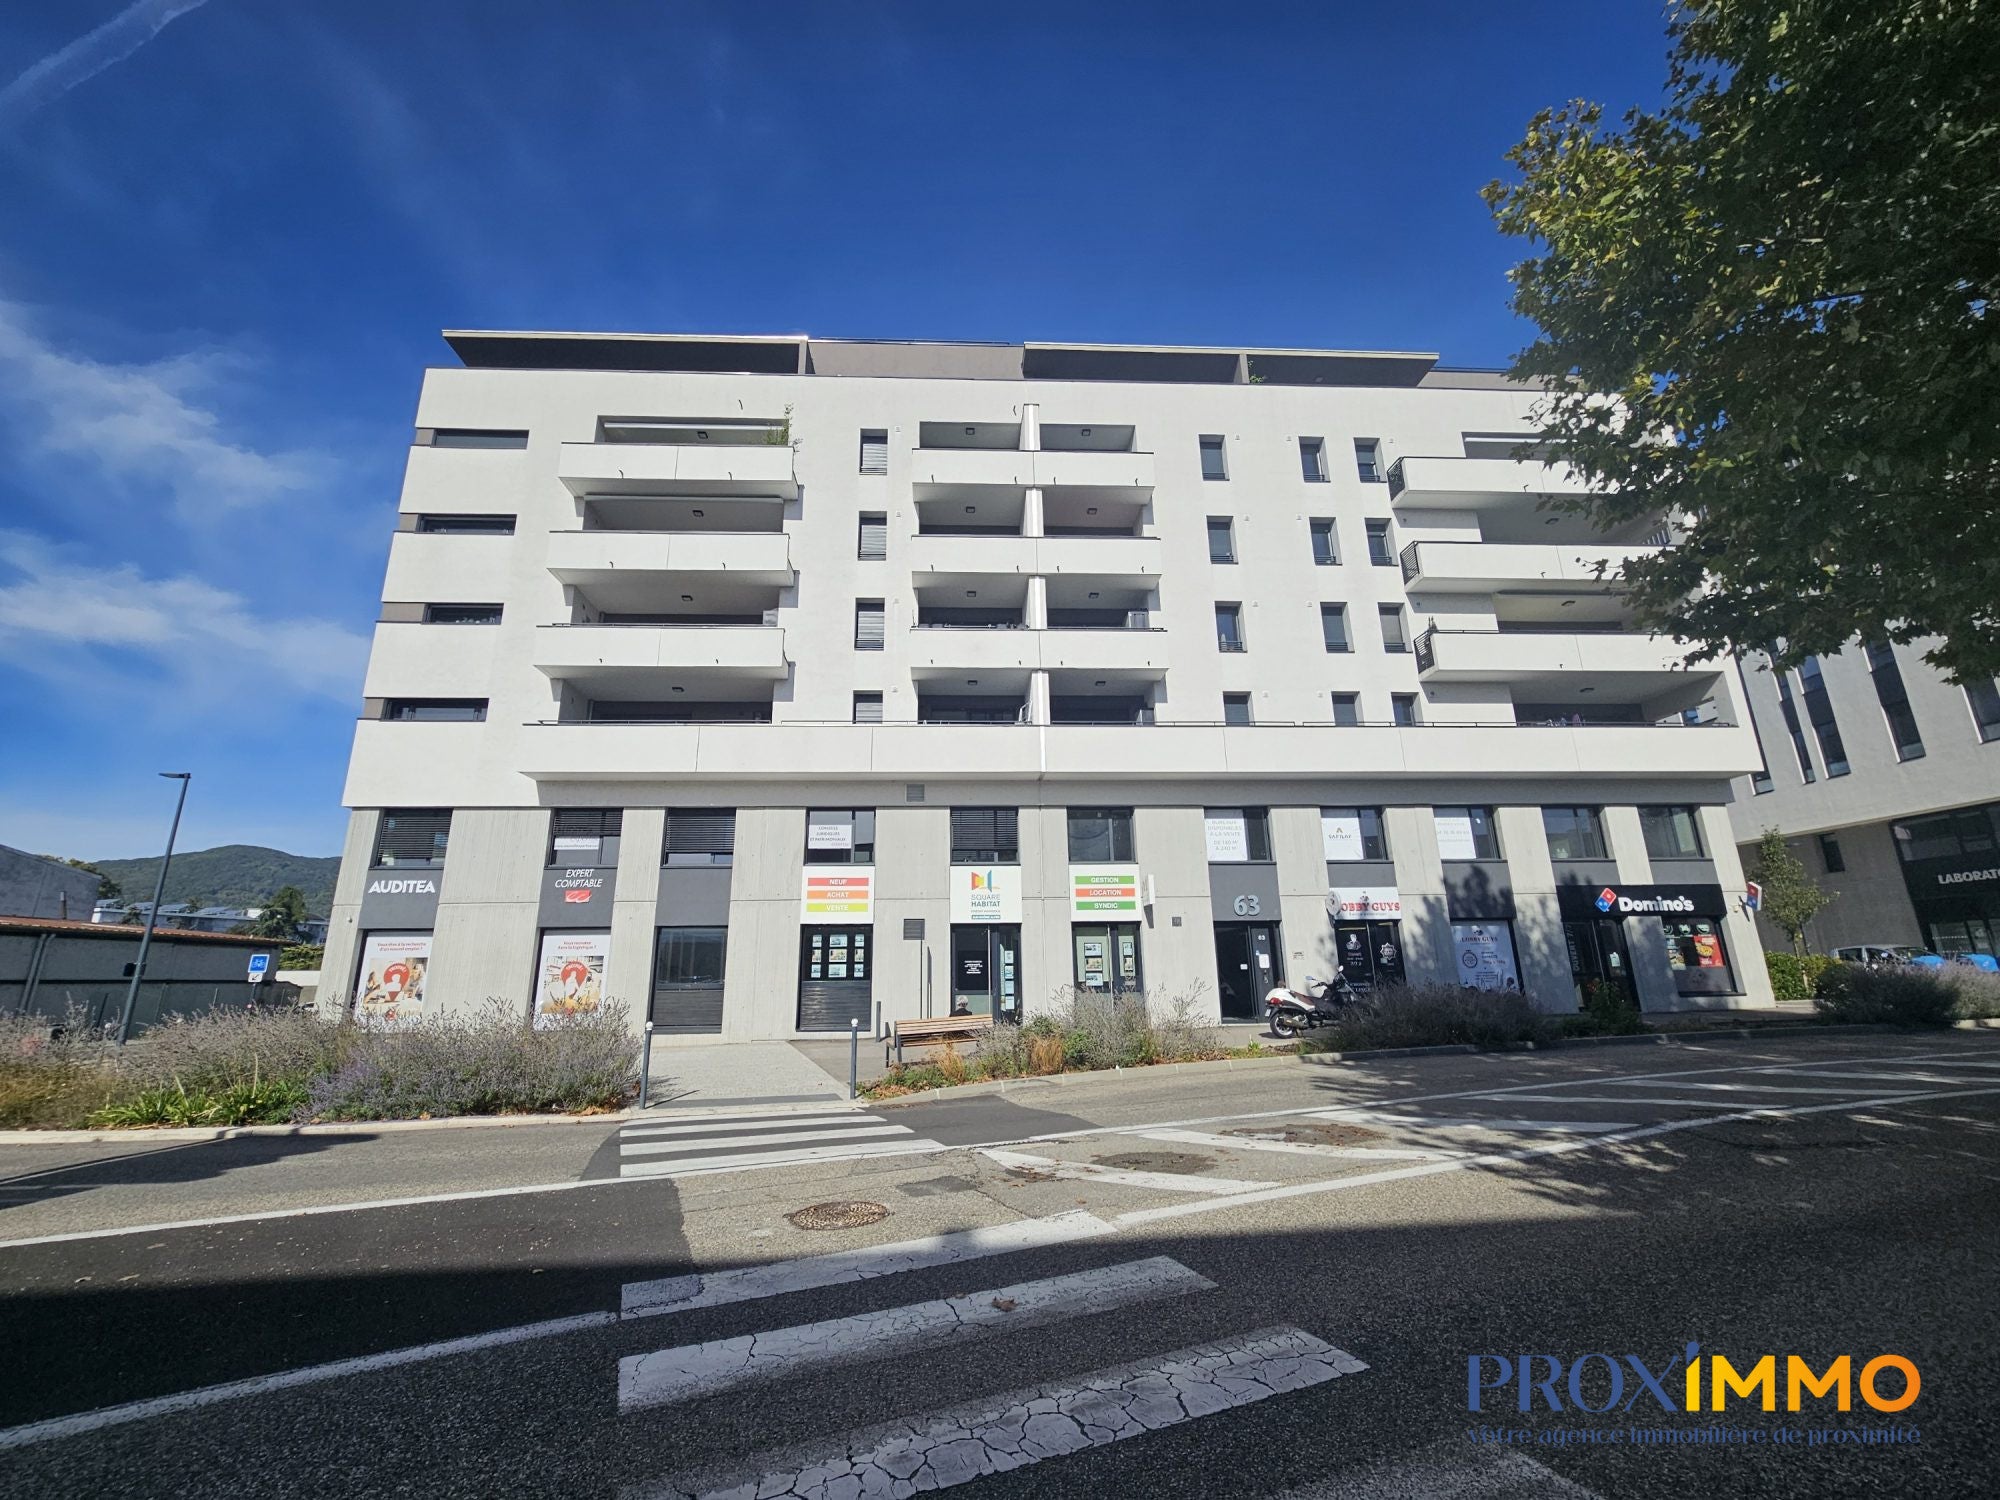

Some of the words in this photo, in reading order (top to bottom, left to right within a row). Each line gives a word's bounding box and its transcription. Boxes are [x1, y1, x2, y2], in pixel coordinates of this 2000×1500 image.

[565, 868, 595, 878] EXPERT
[1938, 868, 2000, 884] LABORAT
[368, 880, 436, 894] AUDITEA
[554, 878, 604, 888] COMPTABLE
[1233, 894, 1261, 916] 63
[1341, 902, 1369, 911] OBBY
[1371, 902, 1400, 911] GUYS
[1618, 895, 1695, 912] Domino's
